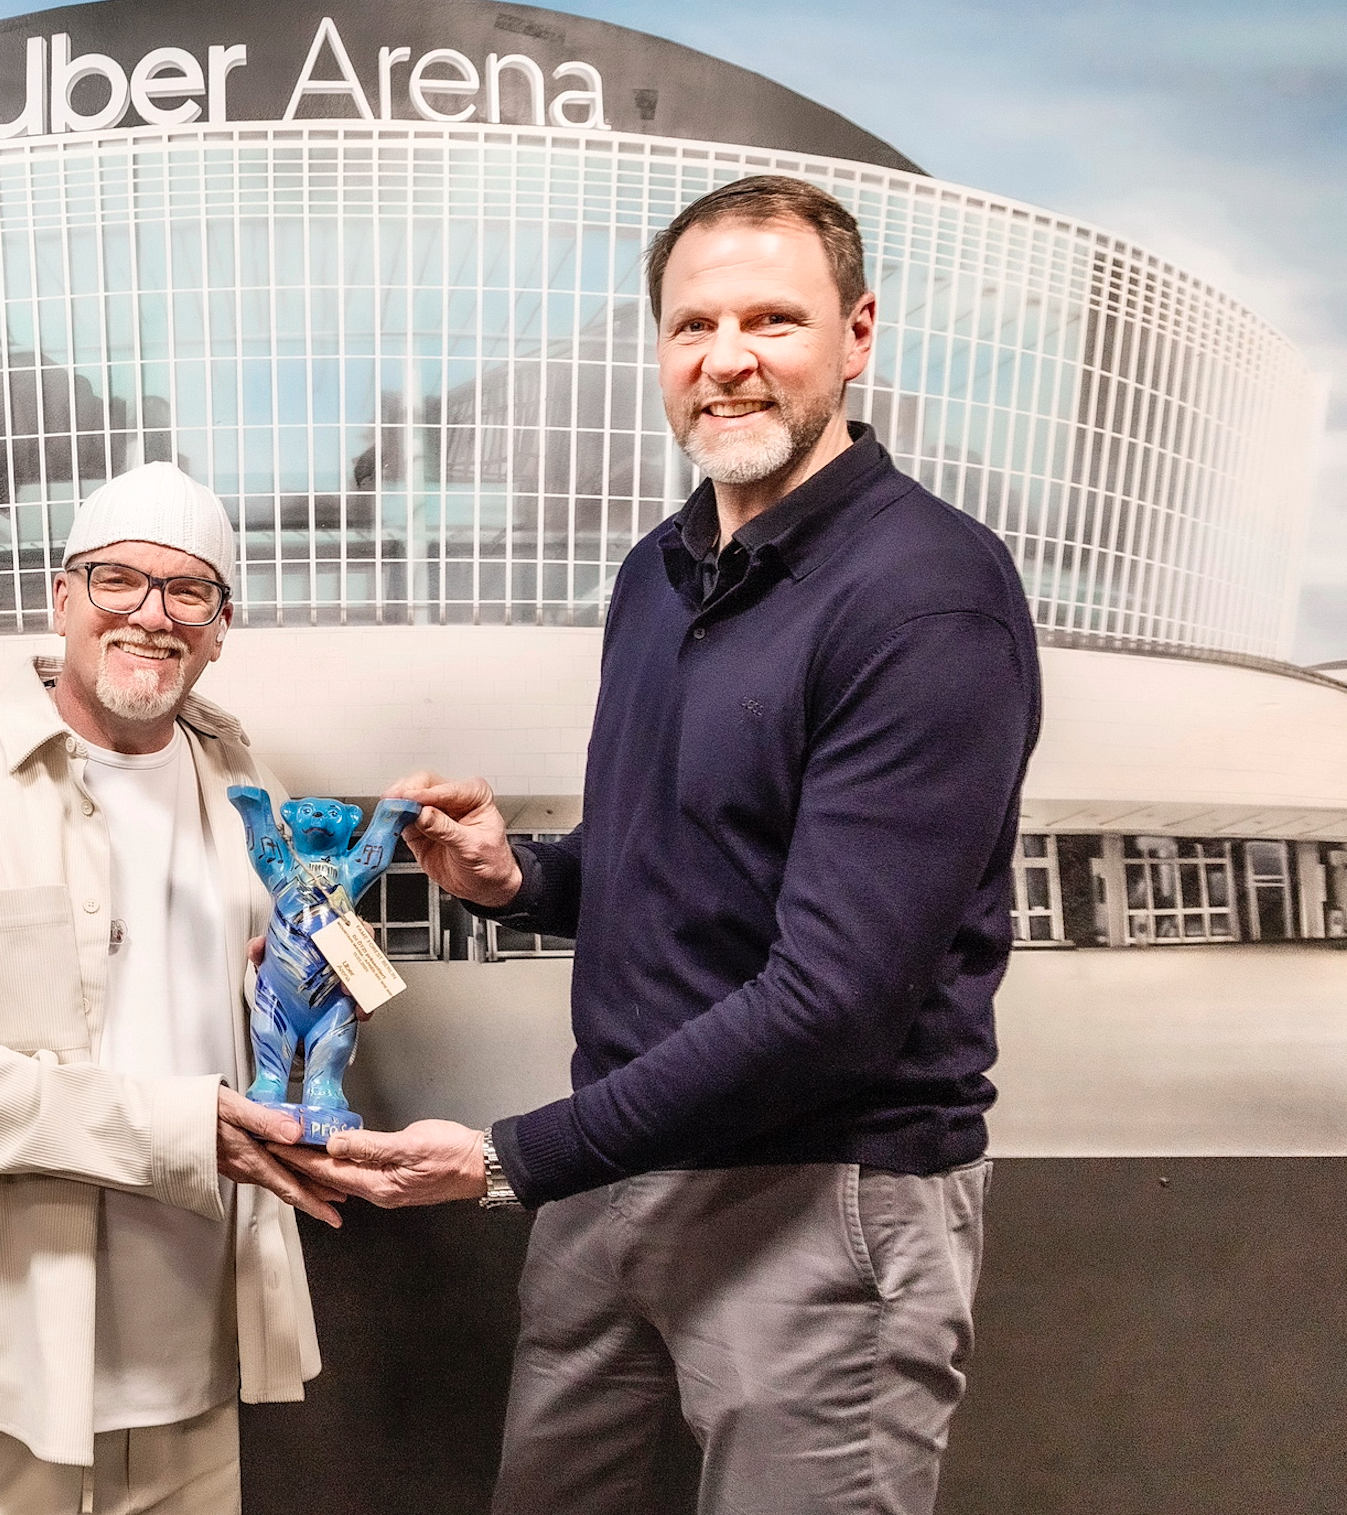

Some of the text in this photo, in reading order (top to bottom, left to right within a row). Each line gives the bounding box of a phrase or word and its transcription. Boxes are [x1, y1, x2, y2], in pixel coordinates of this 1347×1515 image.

[282, 17, 612, 130] Arena
[355, 924, 397, 979] FAME FOREST BERLIN
